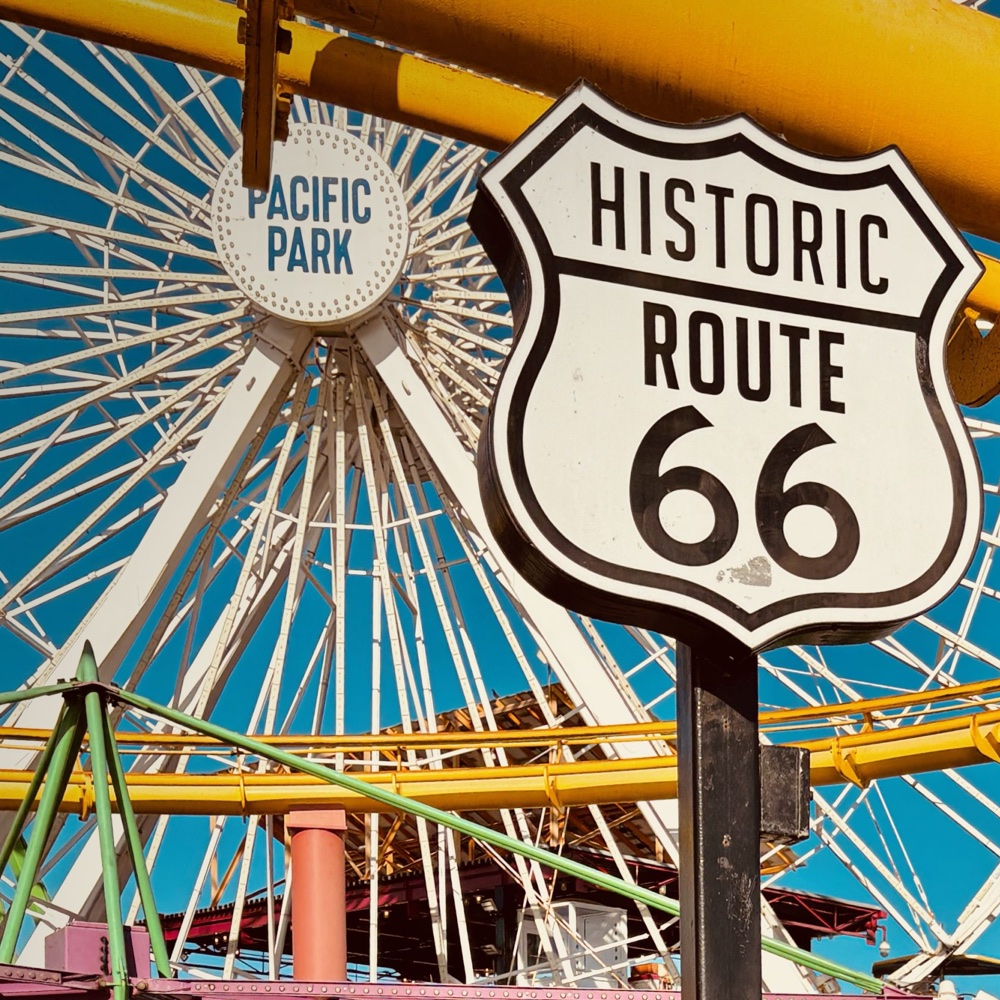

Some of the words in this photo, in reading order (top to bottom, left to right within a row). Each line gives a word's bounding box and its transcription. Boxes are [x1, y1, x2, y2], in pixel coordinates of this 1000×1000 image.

[247, 173, 372, 224] PACIFIC
[267, 225, 354, 275] PARK
[590, 161, 890, 295] HISTORIC
[642, 300, 846, 415] ROUTE
[629, 404, 861, 581] 66
